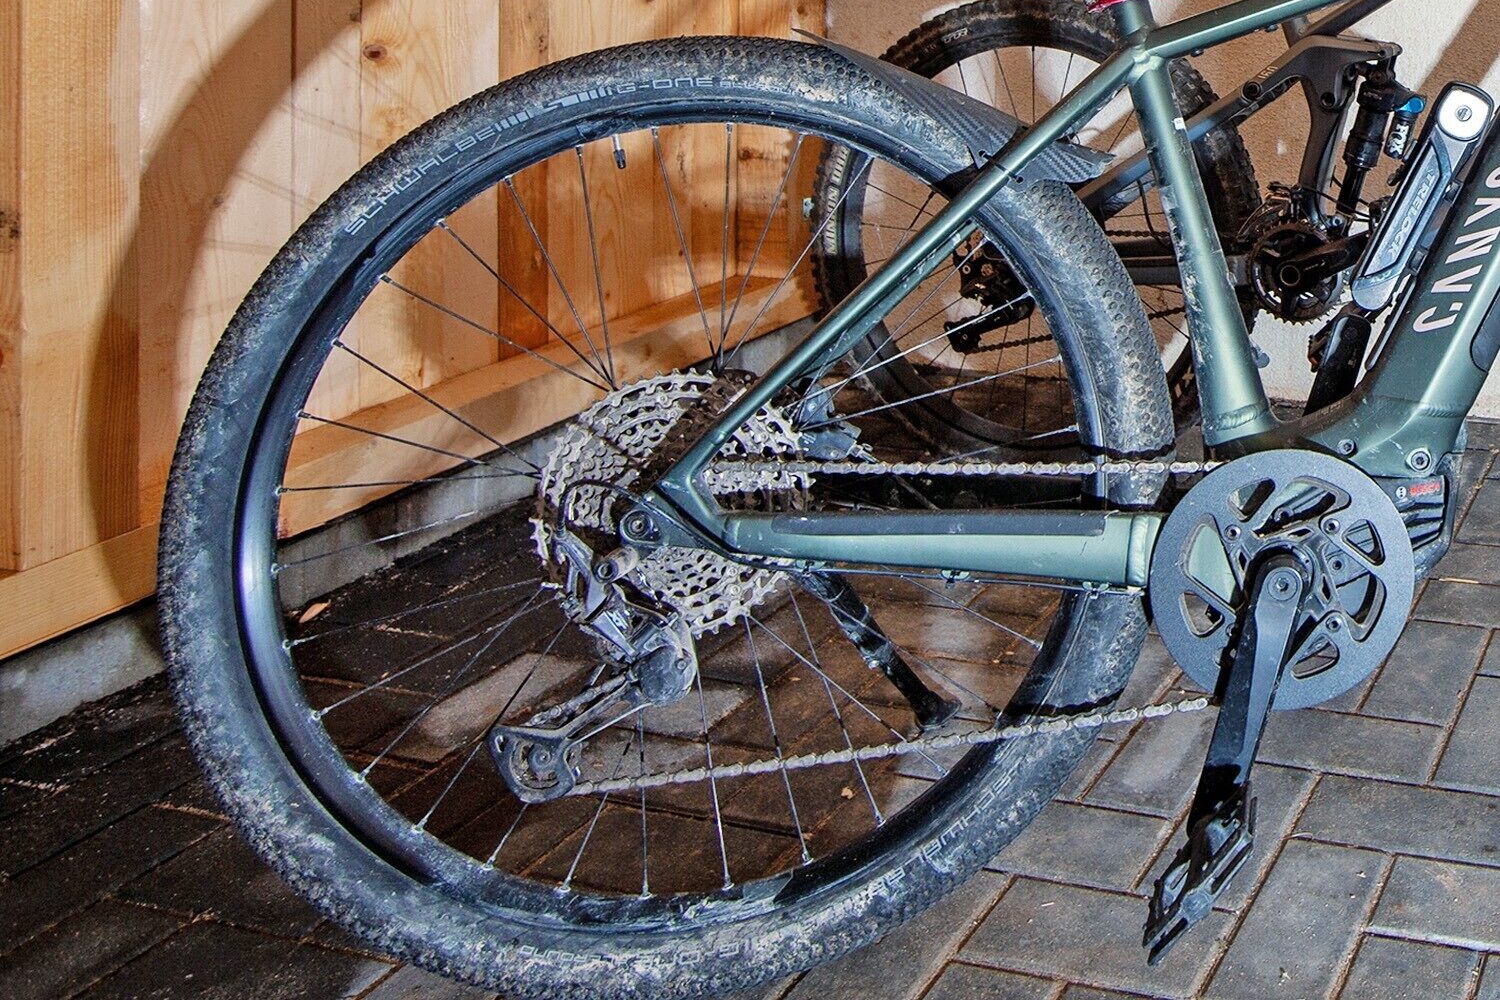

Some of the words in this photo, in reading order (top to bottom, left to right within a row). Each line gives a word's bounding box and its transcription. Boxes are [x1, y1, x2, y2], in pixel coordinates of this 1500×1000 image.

[344, 125, 495, 236] SCHWALBE
[615, 76, 713, 93] G-ONE
[1387, 123, 1410, 155] FOX
[822, 185, 841, 256] MINION
[1387, 172, 1437, 257] TRELOCK
